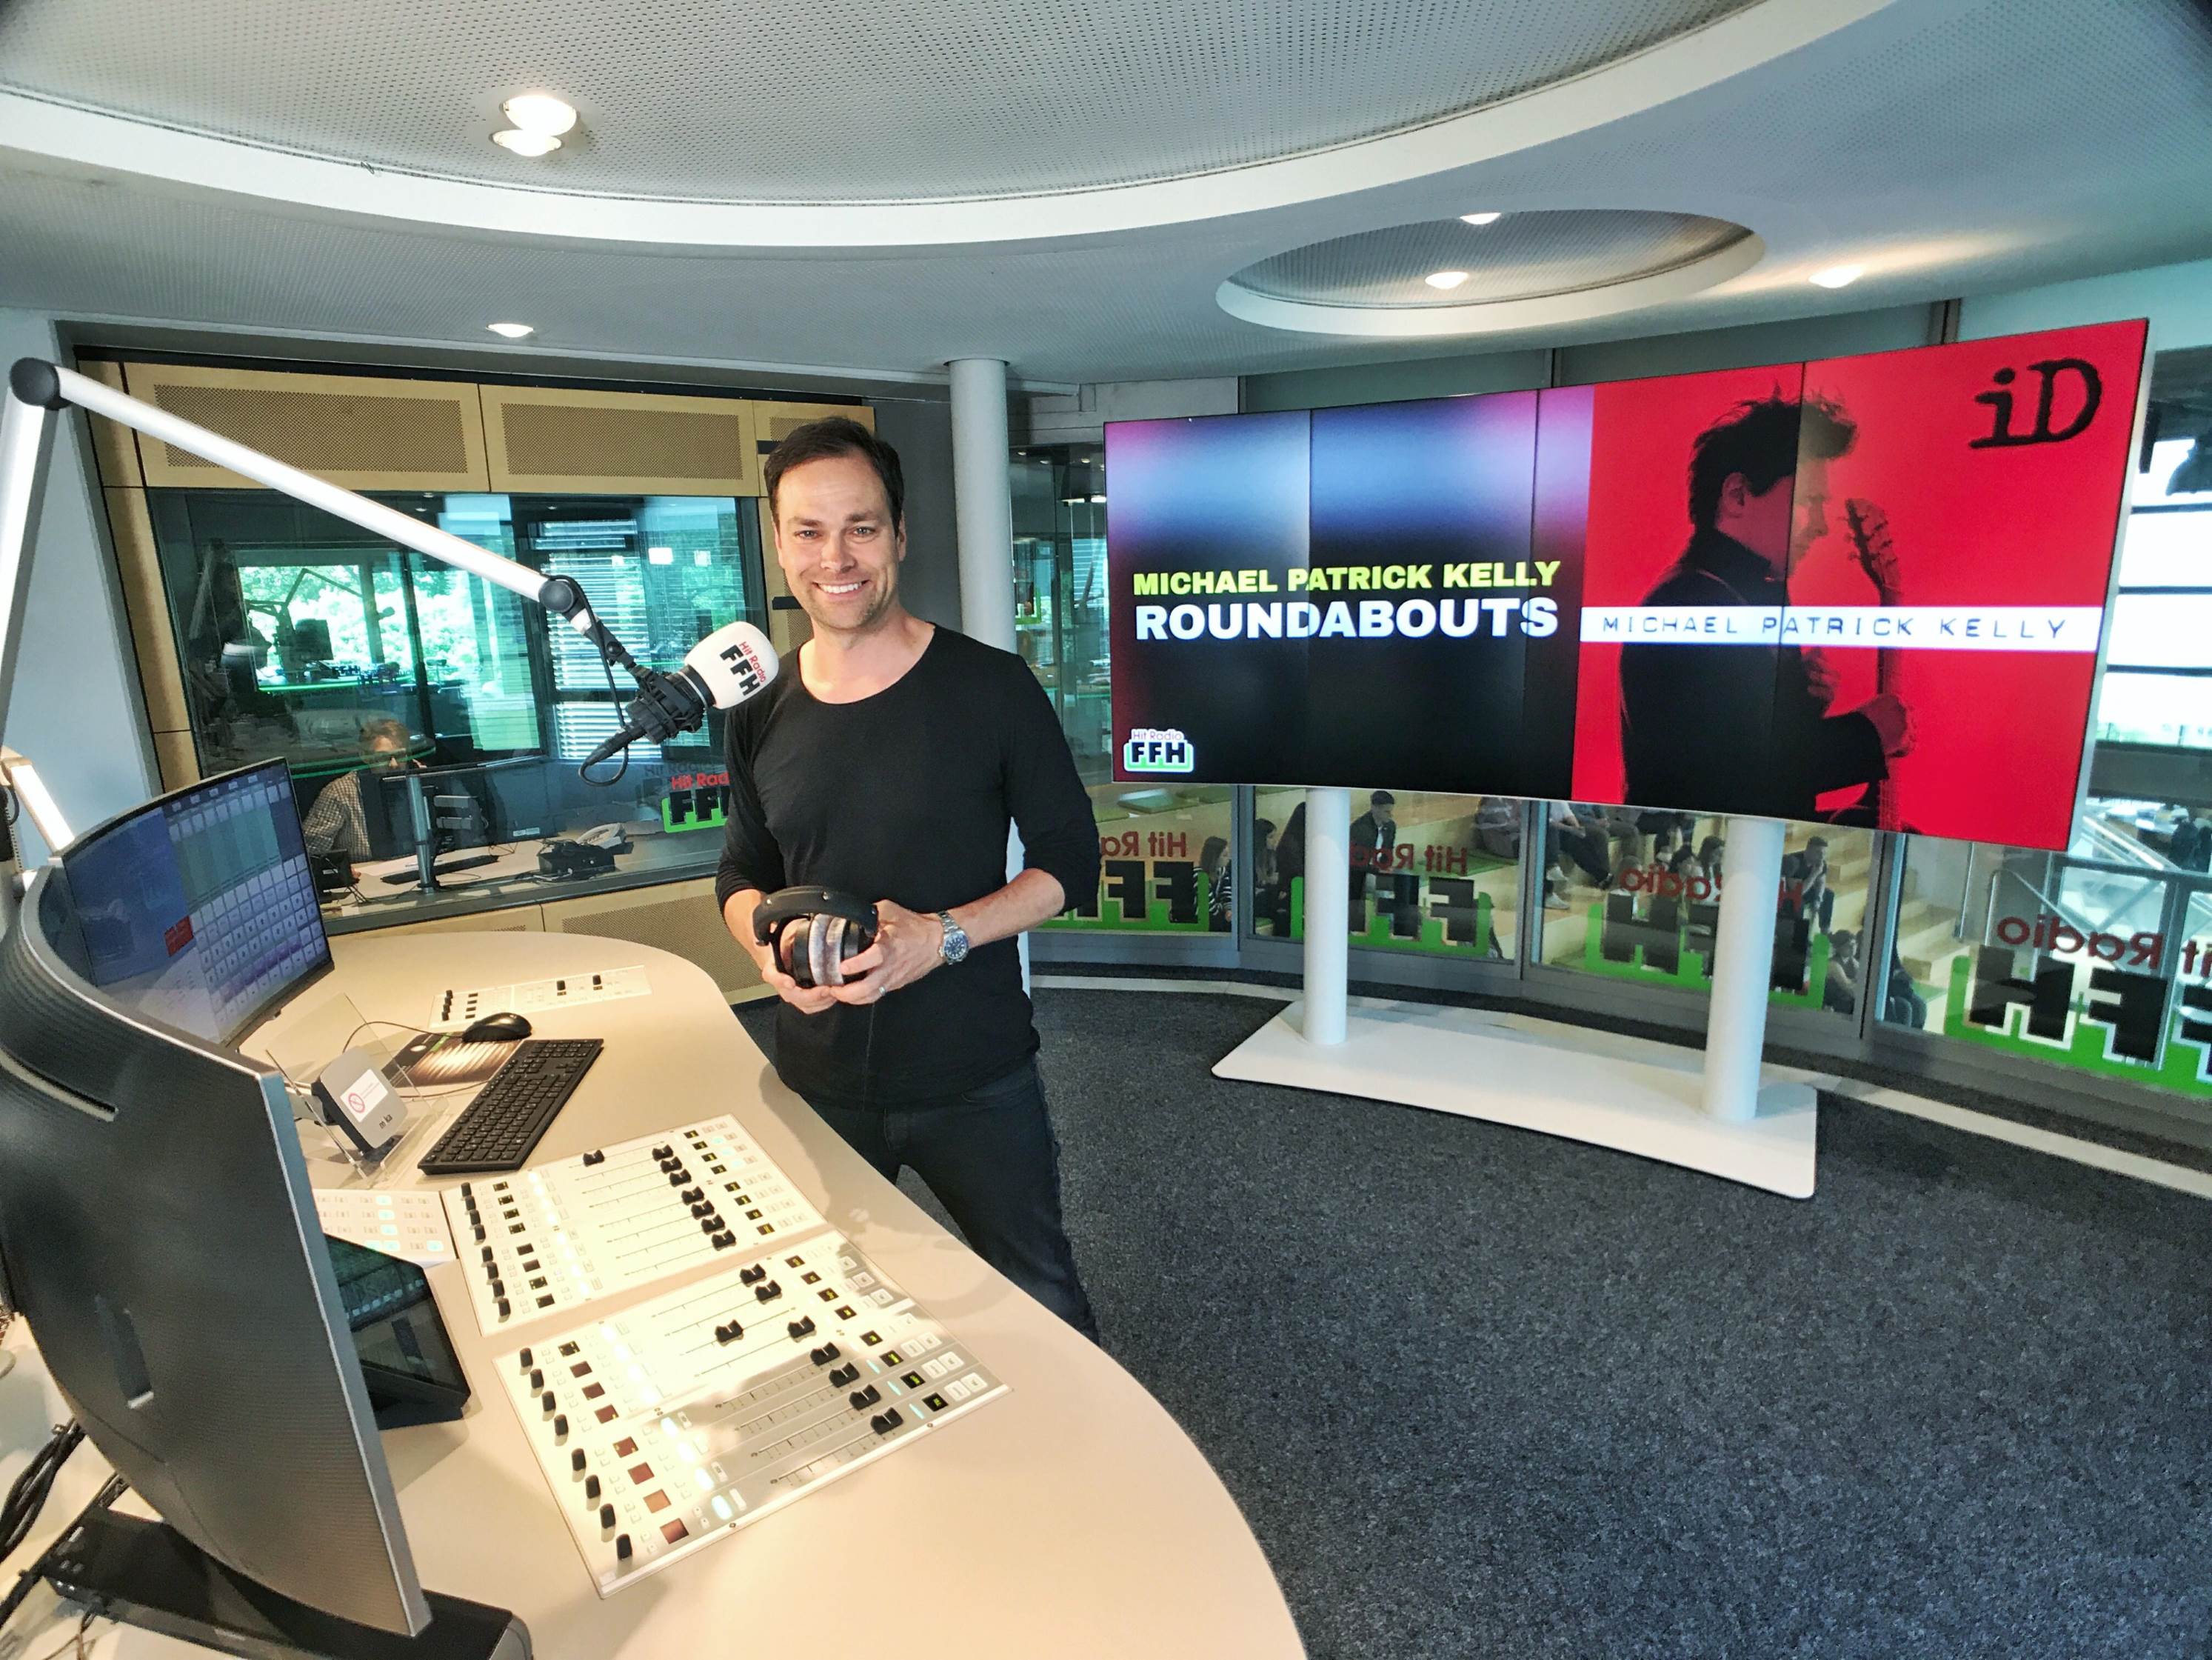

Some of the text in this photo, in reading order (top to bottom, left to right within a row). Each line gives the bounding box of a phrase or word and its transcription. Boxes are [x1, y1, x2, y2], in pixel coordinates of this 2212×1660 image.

[1969, 357, 2102, 449] iD
[1133, 561, 1560, 595] MICHAEL PATRICK KELLY
[1135, 597, 1558, 640] ROUNDABOUTS
[1603, 616, 2065, 639] MICHAEL PATRICK KELLY
[720, 644, 760, 696] FFH
[739, 641, 766, 682] Hit Radio
[1132, 730, 1183, 740] Hit Radio
[1132, 742, 1185, 763] FFH
[671, 772, 729, 790] Hit Rad
